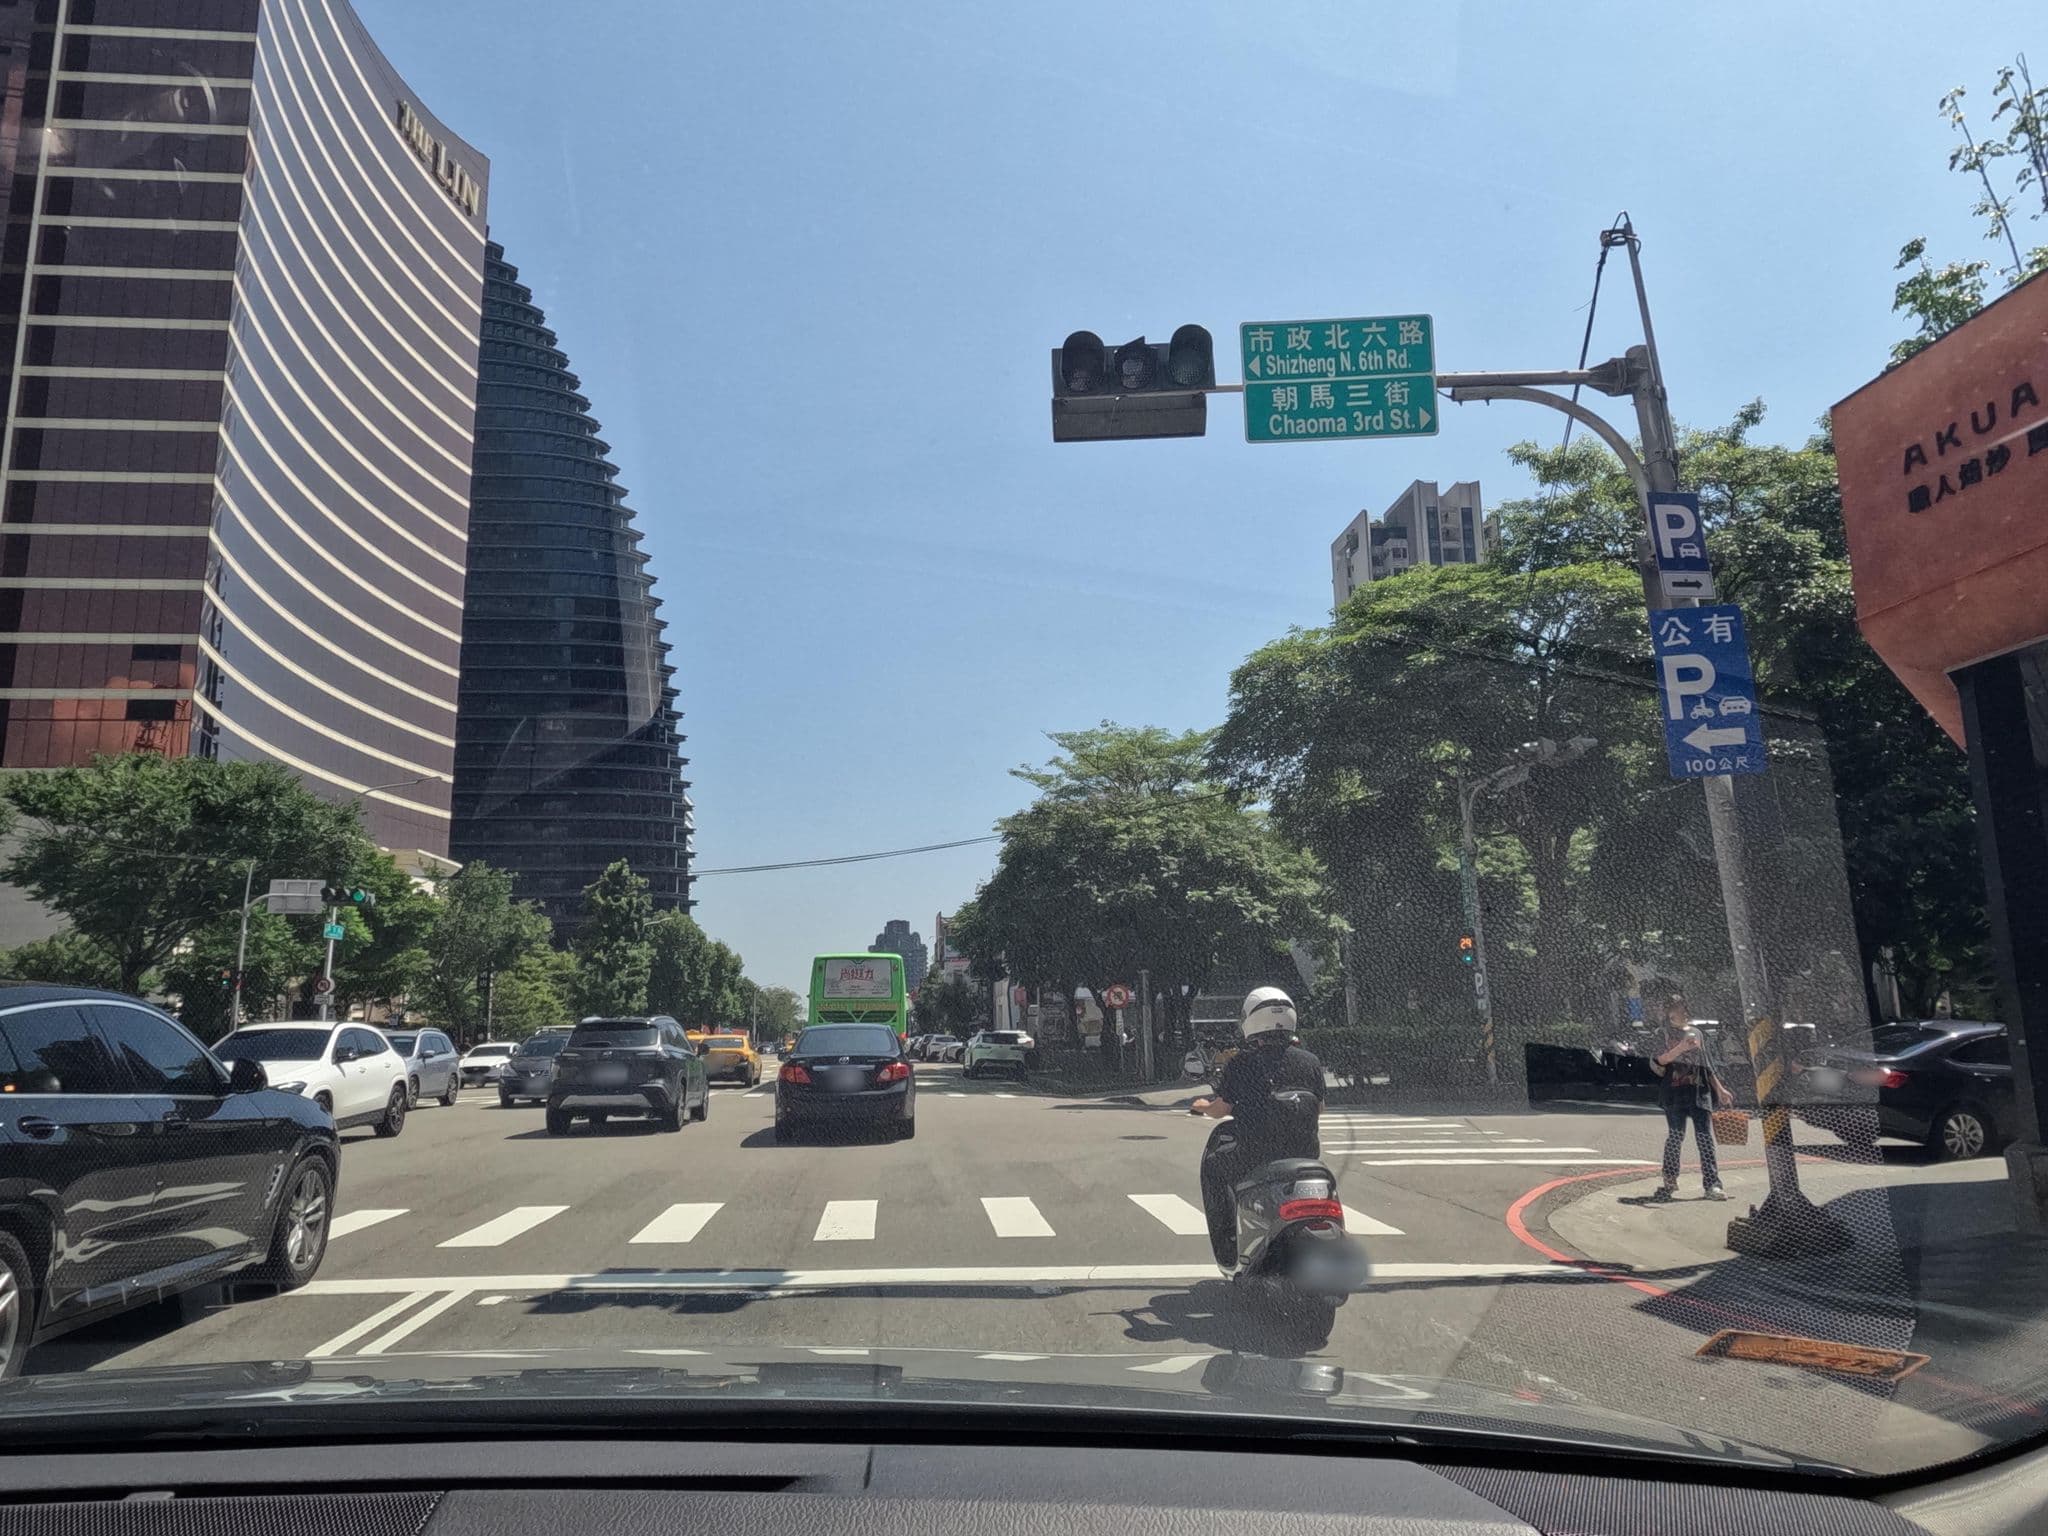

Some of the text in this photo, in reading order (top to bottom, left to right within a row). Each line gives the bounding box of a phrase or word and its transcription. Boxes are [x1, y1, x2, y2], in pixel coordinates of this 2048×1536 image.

[438, 140, 481, 216] LIN
[1248, 320, 1425, 352] 市政北六路
[1266, 350, 1412, 377] Shizheng N. 6th Rd.
[1271, 381, 1410, 411] 朝馬三街
[1269, 408, 1416, 435] Chaoma 3rd St.
[1903, 382, 2039, 475] AKUA
[1654, 504, 1697, 559] P
[1659, 614, 1735, 648] 公有
[1662, 654, 1716, 721] P
[1685, 756, 1750, 773] 100公尺
